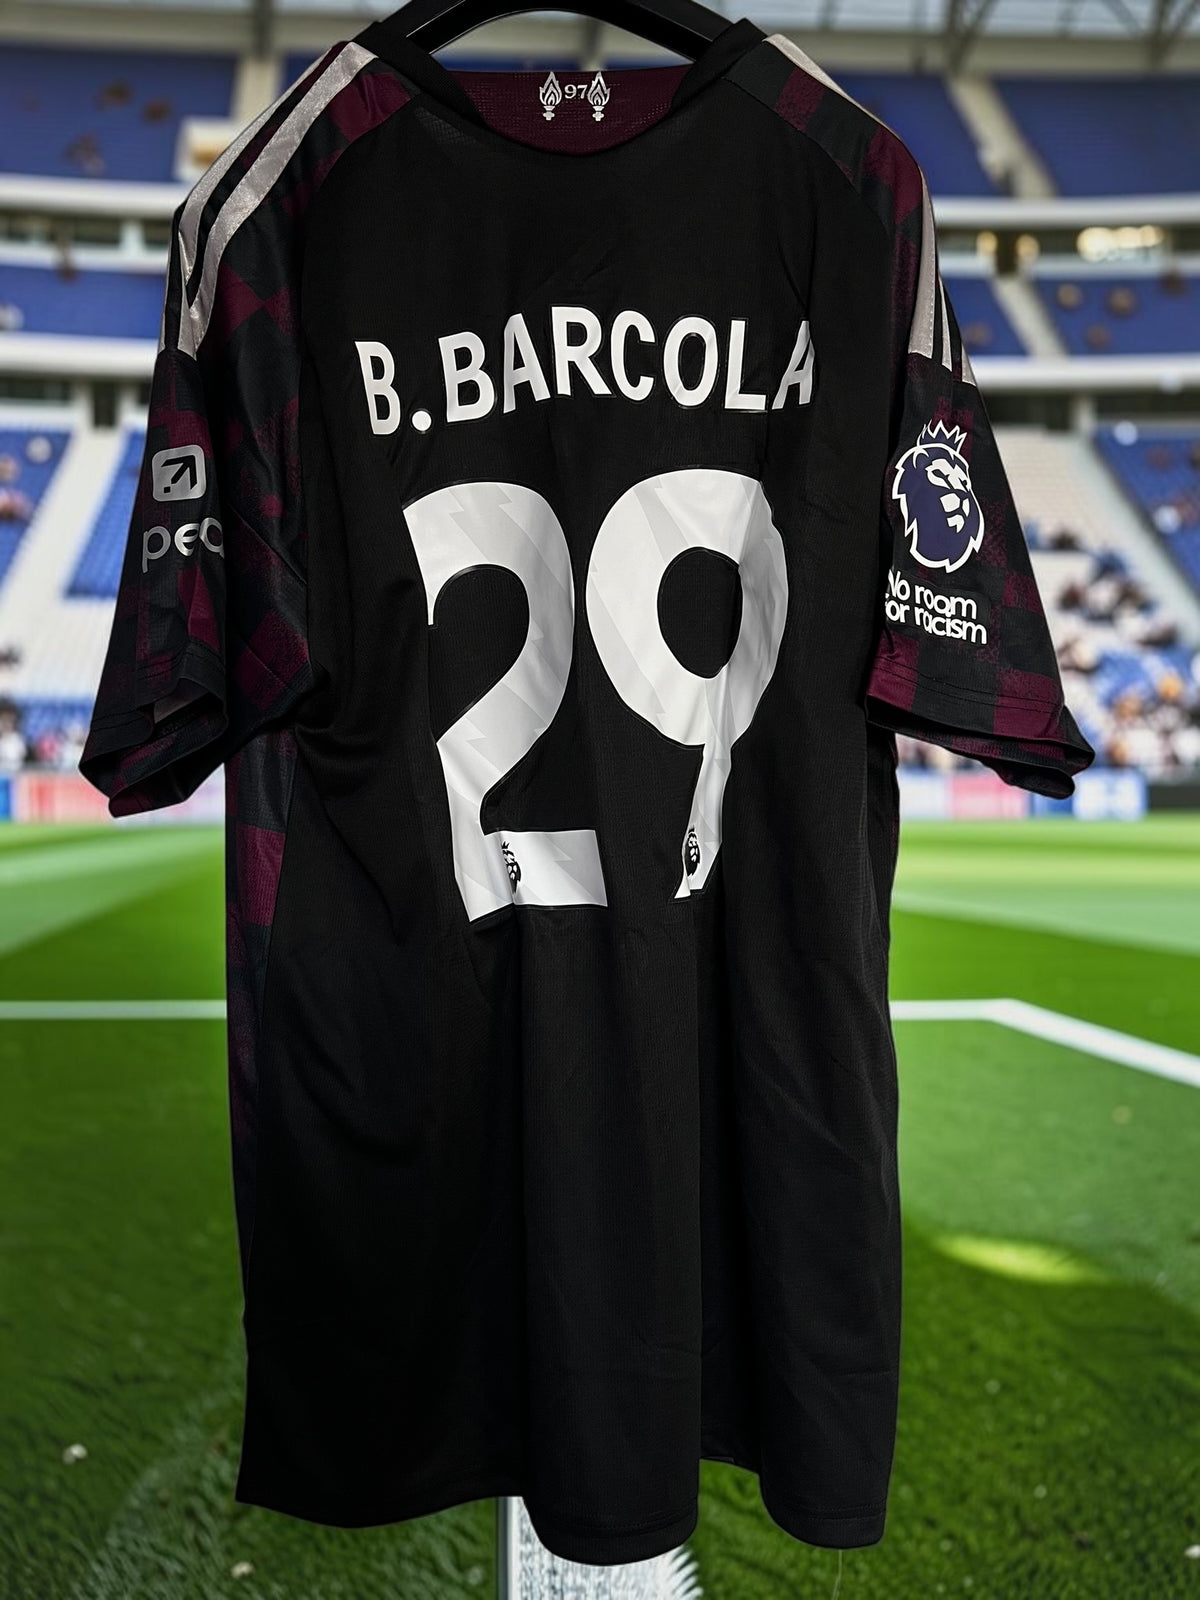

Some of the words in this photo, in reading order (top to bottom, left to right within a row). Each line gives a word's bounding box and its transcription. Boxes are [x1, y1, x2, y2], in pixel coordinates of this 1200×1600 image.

[564, 84, 588, 99] 97
[885, 593, 910, 623] or
[915, 606, 987, 645] racism
[886, 569, 911, 601] No
[915, 585, 977, 619] room
[402, 469, 788, 922] 29
